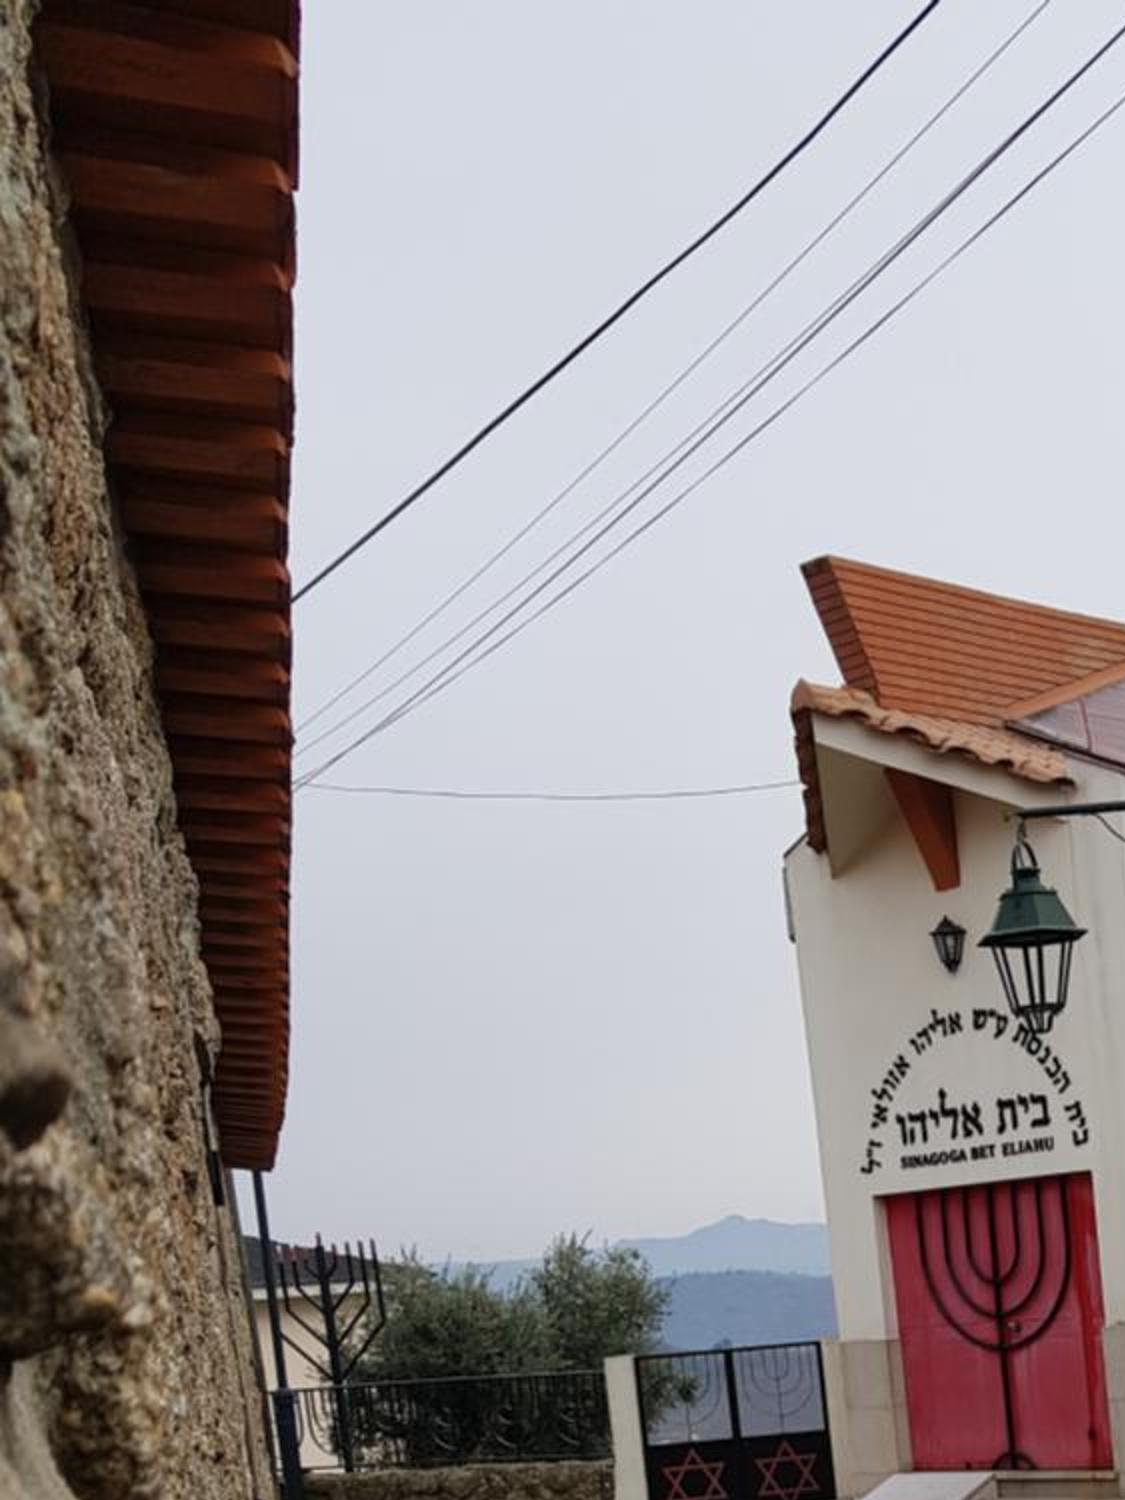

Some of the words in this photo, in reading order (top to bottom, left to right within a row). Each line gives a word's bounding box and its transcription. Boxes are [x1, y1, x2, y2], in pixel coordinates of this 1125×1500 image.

[909, 1009, 963, 1056] אליהו
[1012, 1023, 1072, 1094] הכנסת
[895, 1088, 984, 1146] אליהו
[996, 1092, 1051, 1135] בית
[1064, 1100, 1089, 1146] בית
[900, 1148, 967, 1169] SINAGOGA
[970, 1143, 996, 1161] BET
[1001, 1136, 1055, 1158] ELIAHU
